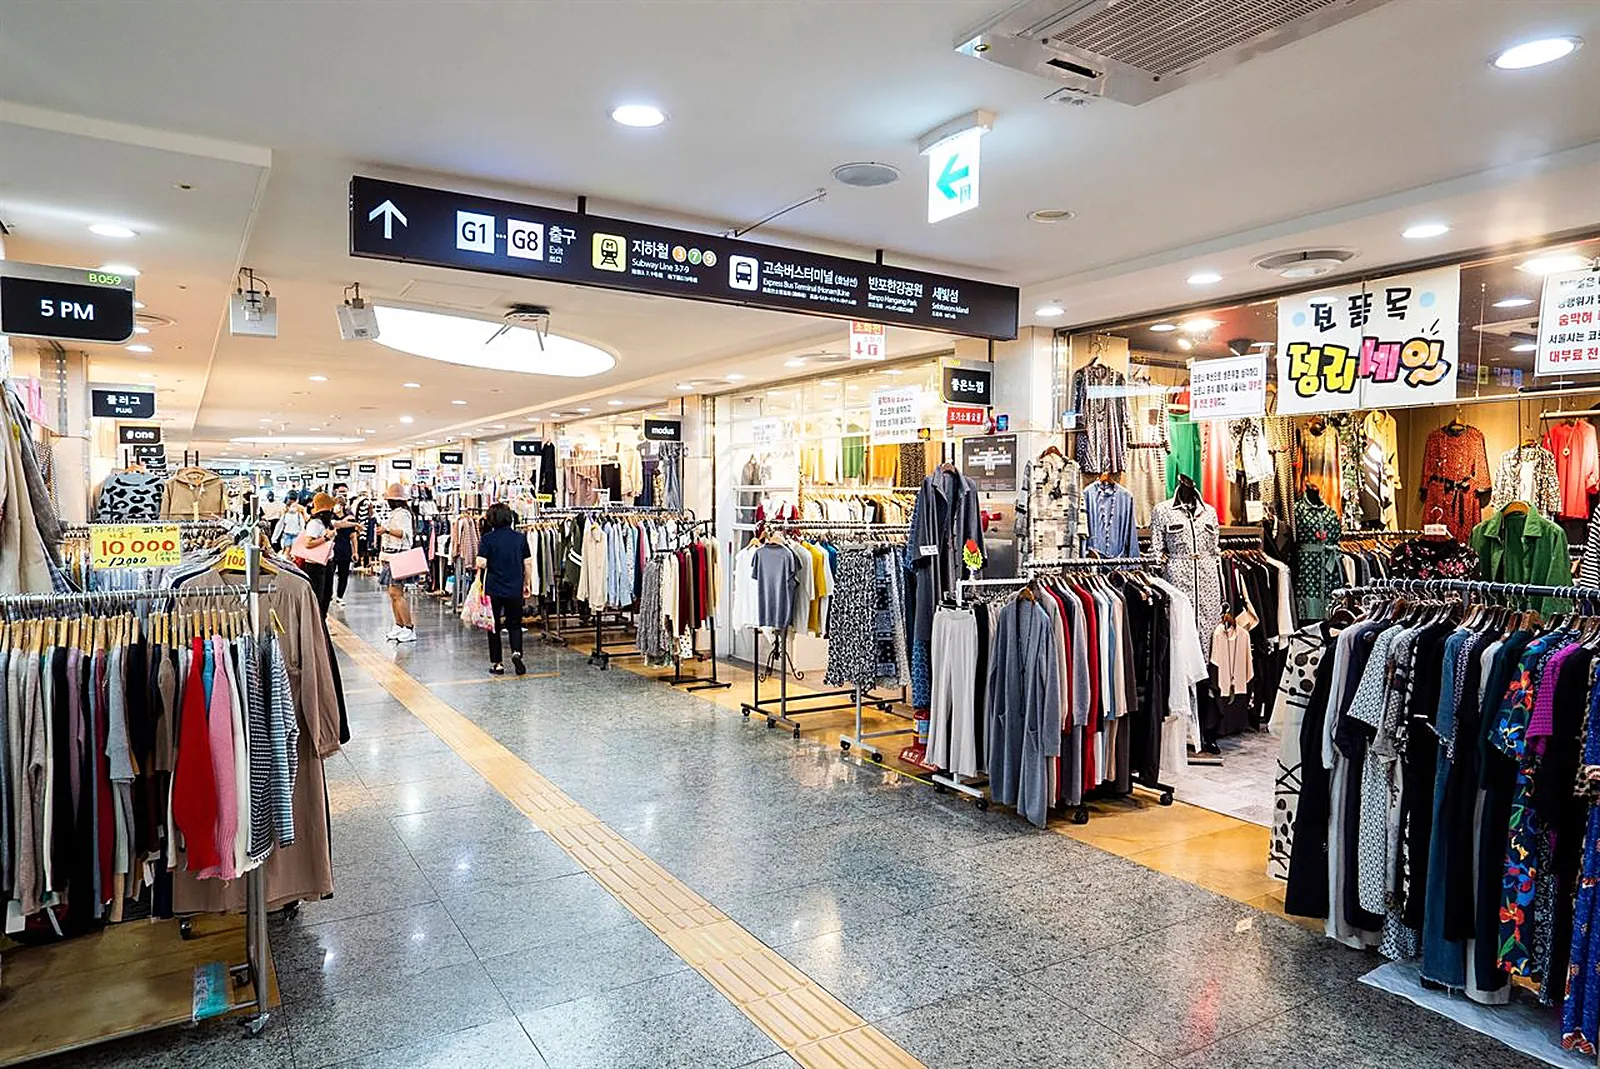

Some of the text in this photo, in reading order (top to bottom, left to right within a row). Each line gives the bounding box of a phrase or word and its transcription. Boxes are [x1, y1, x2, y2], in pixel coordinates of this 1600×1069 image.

[462, 221, 538, 251] G1 G8
[548, 225, 577, 245] 출구
[549, 245, 564, 255] Exit
[632, 239, 669, 260] 지하철
[632, 258, 659, 270] Subway
[660, 262, 674, 271] Line
[89, 273, 121, 285] B059
[762, 261, 833, 284] 고속버스터미널
[763, 278, 783, 287] Express
[783, 281, 794, 289] Bus
[794, 282, 816, 292] Terminal
[868, 276, 923, 298] 반포한강공원
[868, 293, 918, 307] Banpo Hangang Park
[932, 287, 958, 303] 세빛섬
[41, 299, 94, 320] 5 PM
[1548, 332, 1585, 344] 서울시는
[1549, 348, 1583, 363] 대부료
[951, 378, 984, 394] 좋은느낌
[106, 394, 141, 405] 플러그
[652, 426, 674, 435] modus
